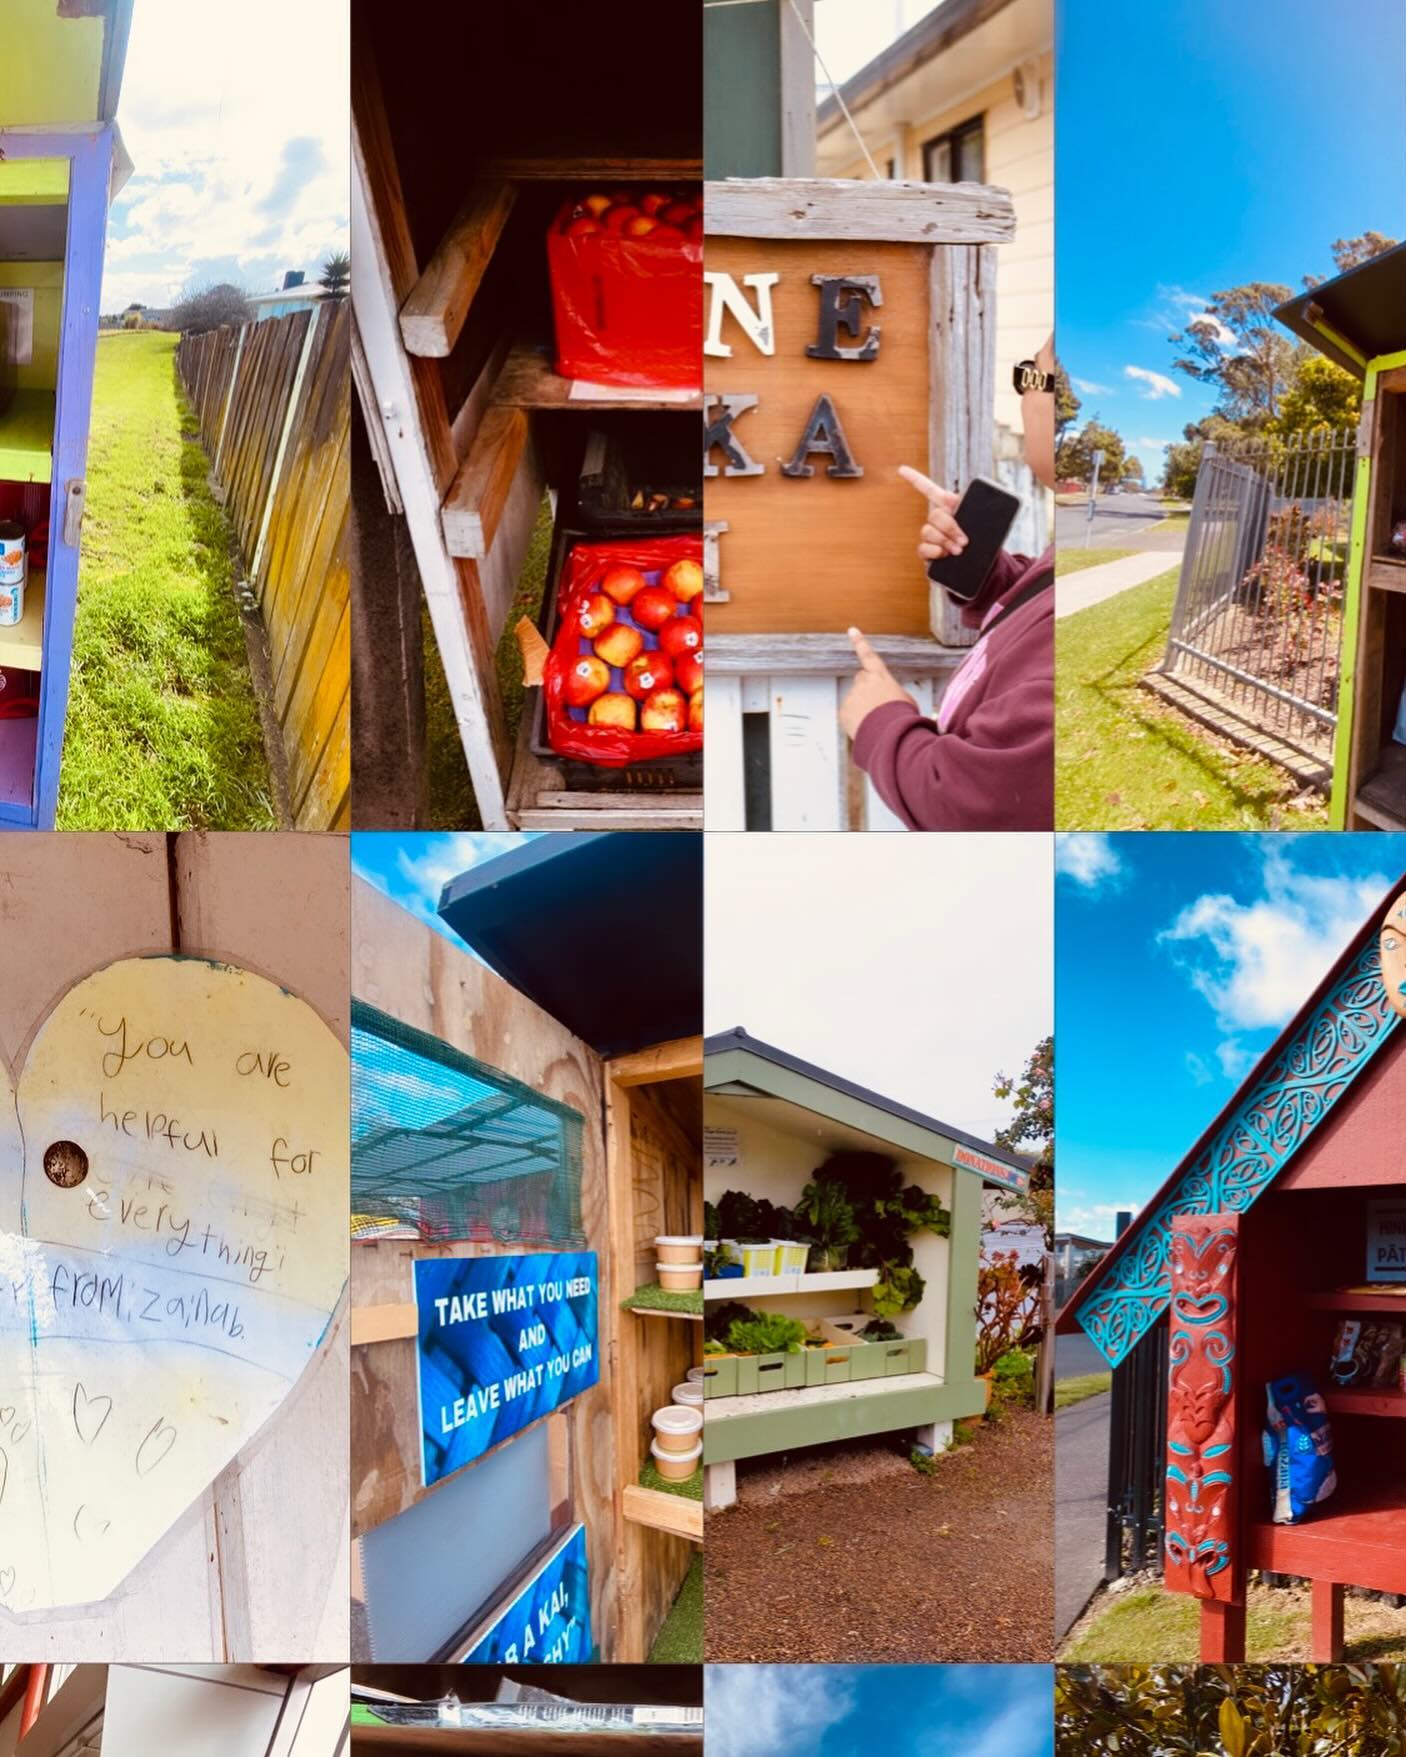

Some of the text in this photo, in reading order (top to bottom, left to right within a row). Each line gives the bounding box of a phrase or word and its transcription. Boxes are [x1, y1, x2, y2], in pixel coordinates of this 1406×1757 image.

[236, 1051, 292, 1088] are
[270, 1137, 321, 1179] for
[434, 1276, 591, 1327] TAKE WHAT YOU NEED
[518, 1323, 546, 1352] AND
[440, 1343, 593, 1434] LEAVE WHAT YOU CAN
[523, 1623, 536, 1658] A
[538, 1581, 569, 1636] KAI,
